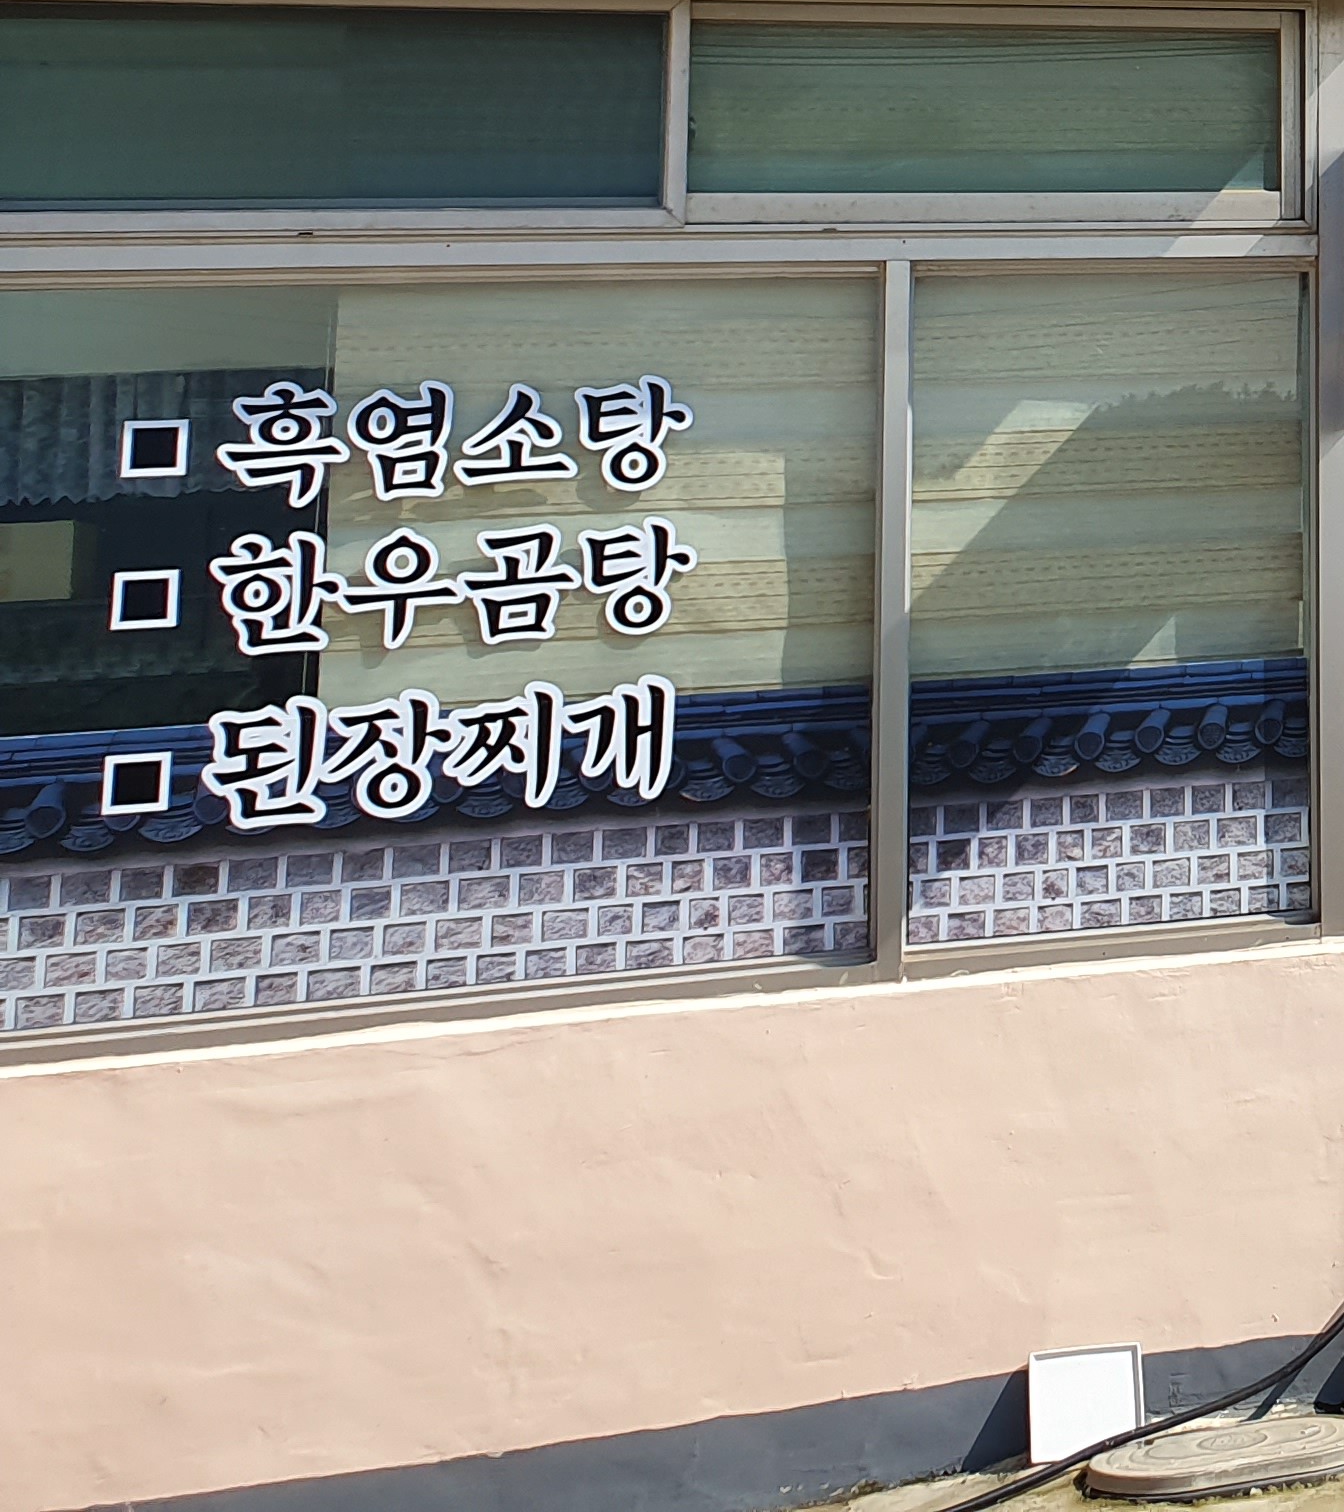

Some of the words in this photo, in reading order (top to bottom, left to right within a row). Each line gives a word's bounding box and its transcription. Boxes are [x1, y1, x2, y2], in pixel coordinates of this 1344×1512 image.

[217, 374, 694, 508] 흑염소탕
[209, 515, 697, 656] 한우곰탕
[201, 674, 677, 829] 된장찌개
